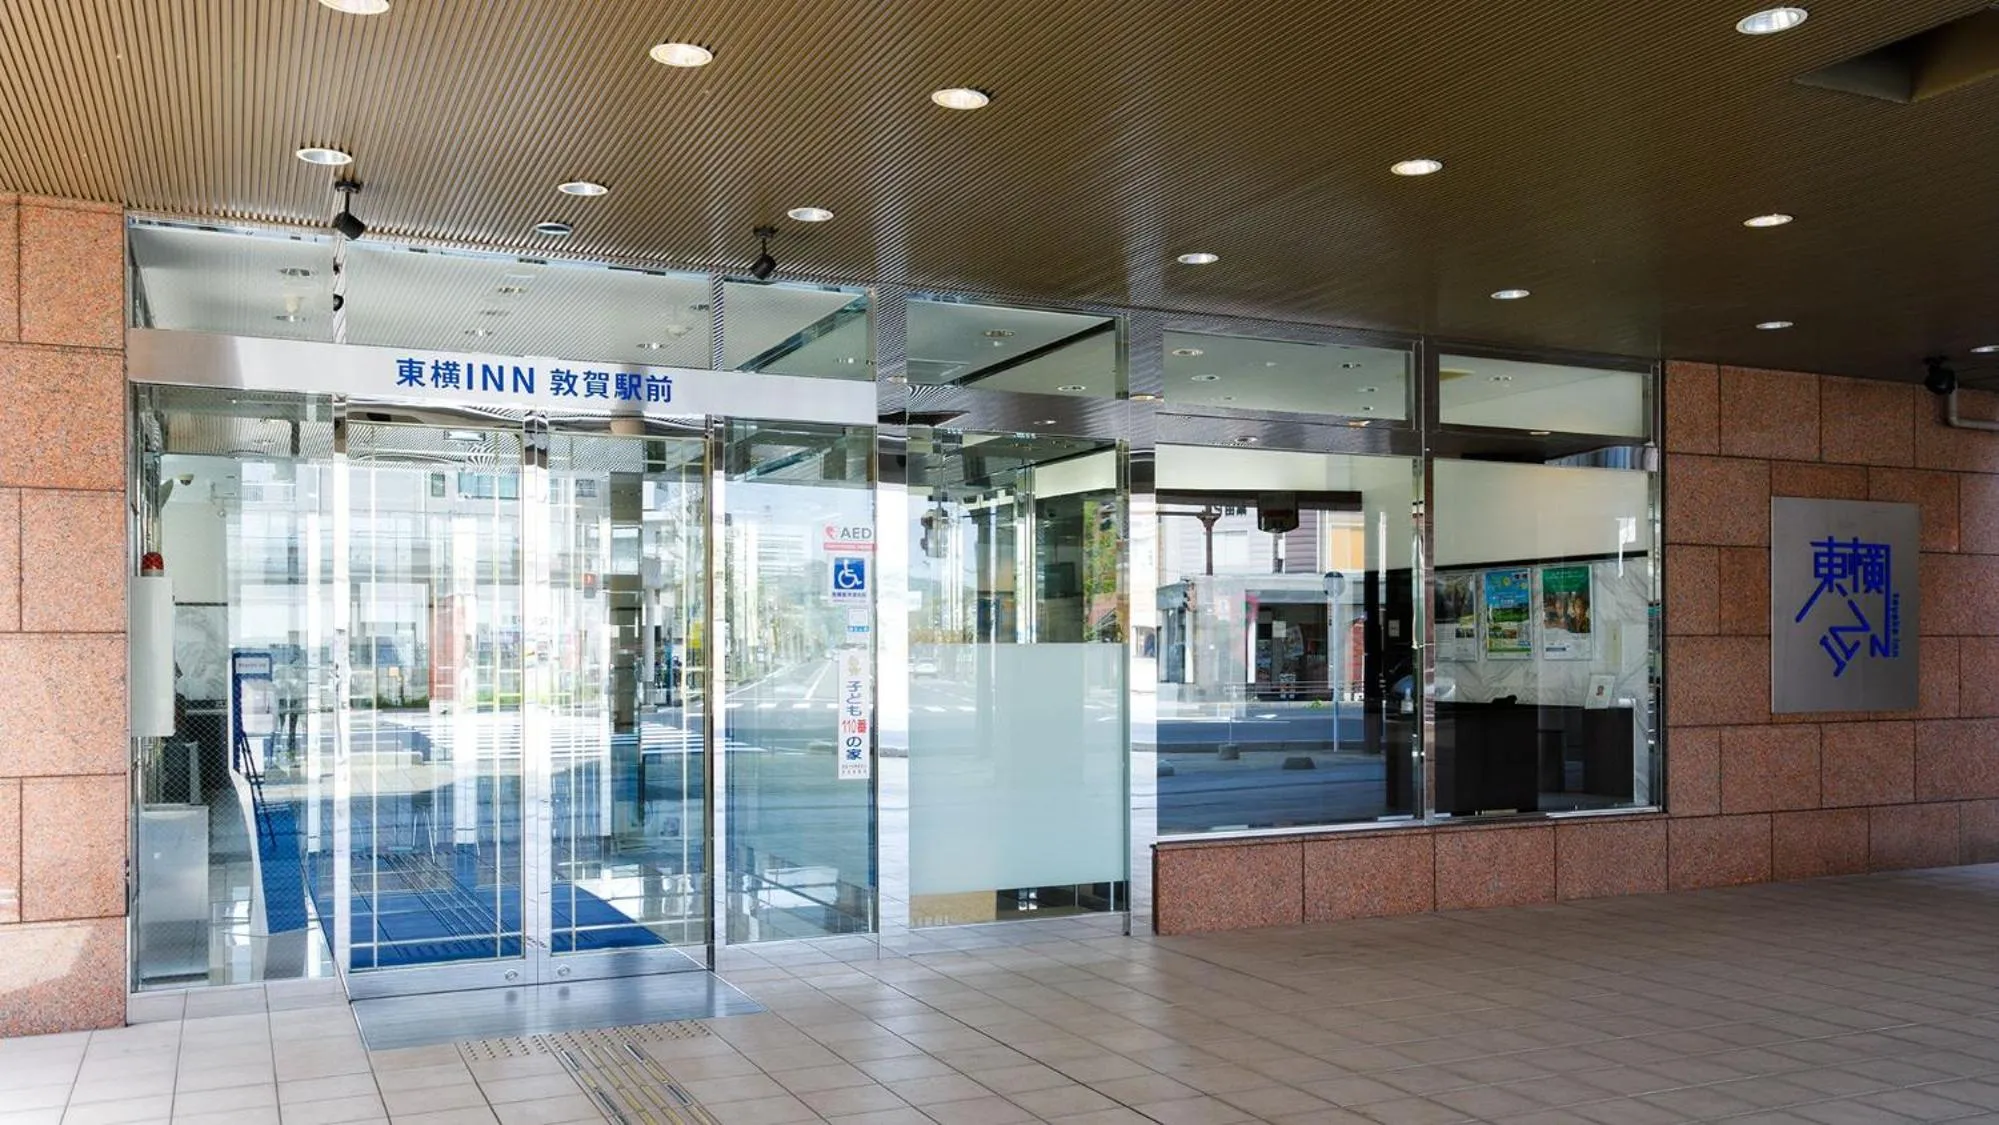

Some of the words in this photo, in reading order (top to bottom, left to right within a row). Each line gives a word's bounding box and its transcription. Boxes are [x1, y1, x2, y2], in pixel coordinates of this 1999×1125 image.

[396, 358, 535, 394] 東横INN
[550, 368, 673, 403] 敦賀駅前
[840, 527, 872, 539] AED
